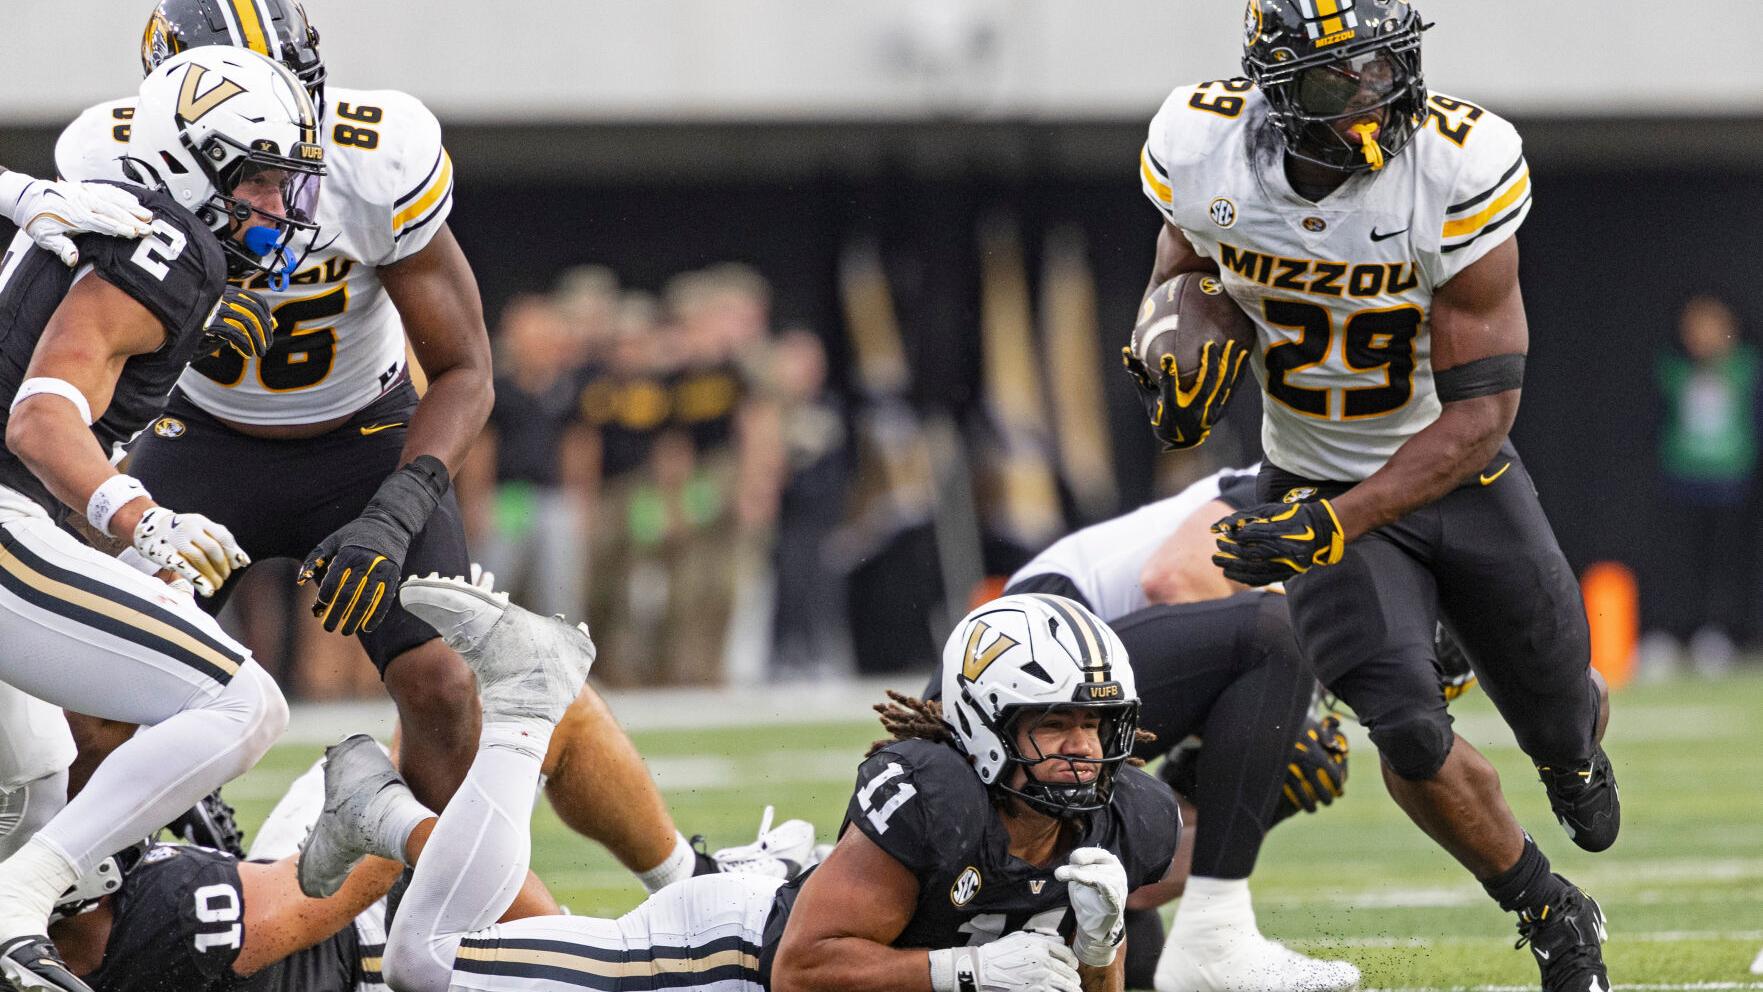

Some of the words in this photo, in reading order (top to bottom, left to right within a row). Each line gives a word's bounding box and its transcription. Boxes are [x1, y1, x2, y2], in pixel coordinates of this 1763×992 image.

[1314, 29, 1356, 49] MIZZOU
[176, 62, 248, 125] V
[1187, 79, 1256, 120] 29
[1421, 94, 1485, 149] 29
[300, 144, 323, 160] VUFB
[332, 101, 384, 151] 86
[1209, 199, 1235, 226] SEC
[130, 218, 188, 282] 2
[1217, 240, 1420, 298] MIZZOU
[1262, 296, 1425, 421] 29
[962, 620, 1021, 684] V
[1090, 683, 1119, 700] VUFB
[856, 762, 918, 836] 11
[193, 883, 242, 954] 10
